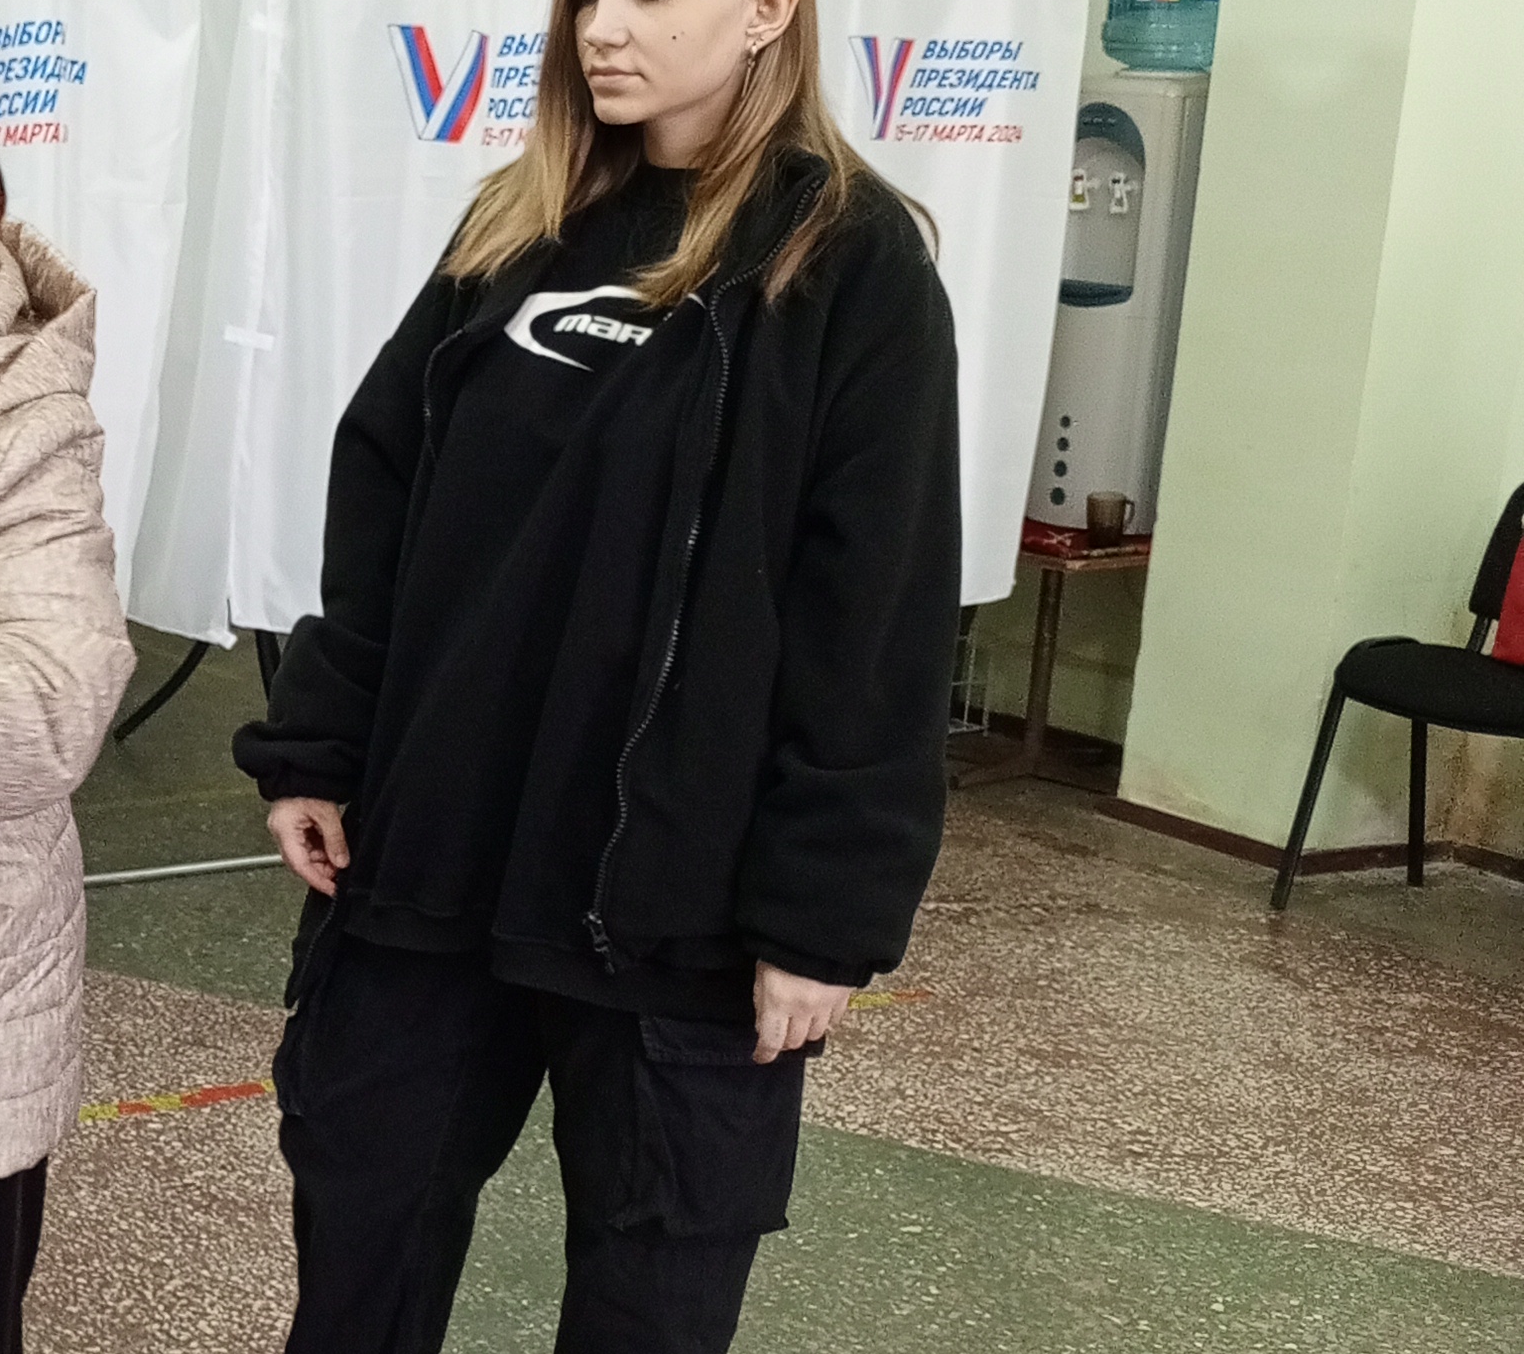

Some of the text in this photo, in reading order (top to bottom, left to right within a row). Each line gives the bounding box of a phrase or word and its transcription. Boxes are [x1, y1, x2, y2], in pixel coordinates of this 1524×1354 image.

[921, 39, 1024, 61] ВЫБОРЫ
[909, 68, 1040, 92] ПРЕЗИДЕНТА
[900, 97, 988, 118] РОССИИ
[3, 122, 61, 146] МАРТА
[929, 124, 985, 142] МАРТА
